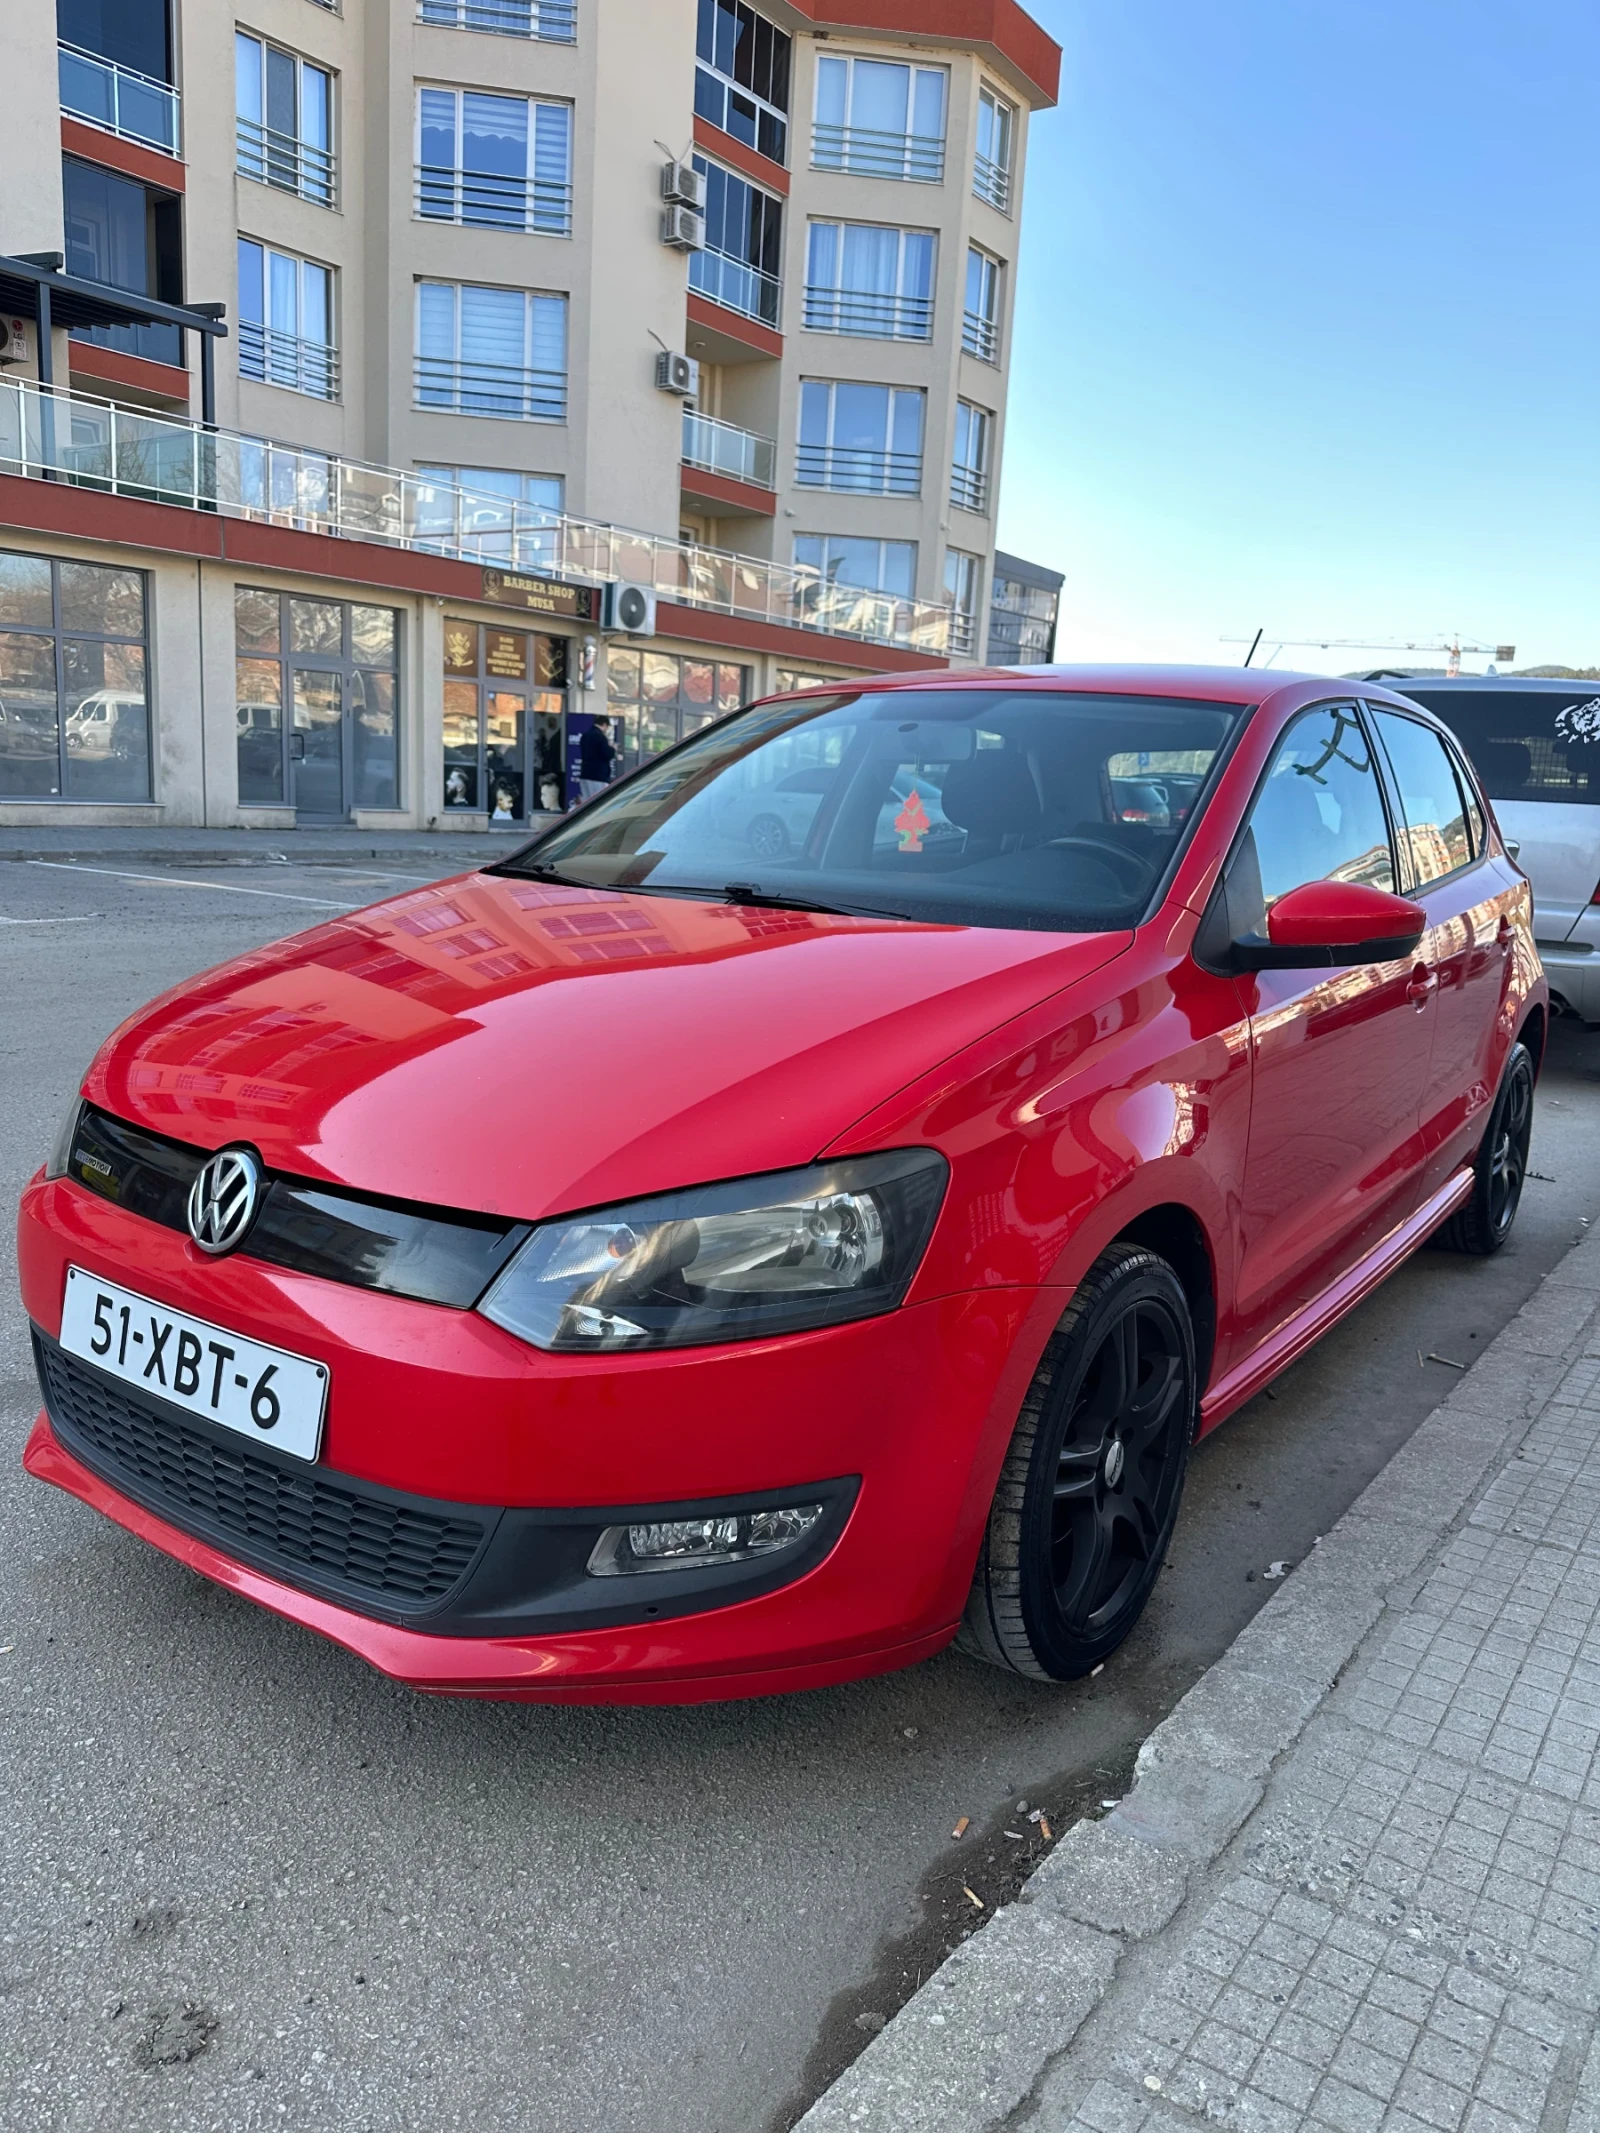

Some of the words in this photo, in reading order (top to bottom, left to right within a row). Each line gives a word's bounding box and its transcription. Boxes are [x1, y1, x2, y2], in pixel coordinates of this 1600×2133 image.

[503, 575, 546, 594] BARBER
[548, 584, 576, 599] SHOP
[527, 595, 556, 611] MUSA
[90, 1293, 281, 1430] 51-XBT-6
